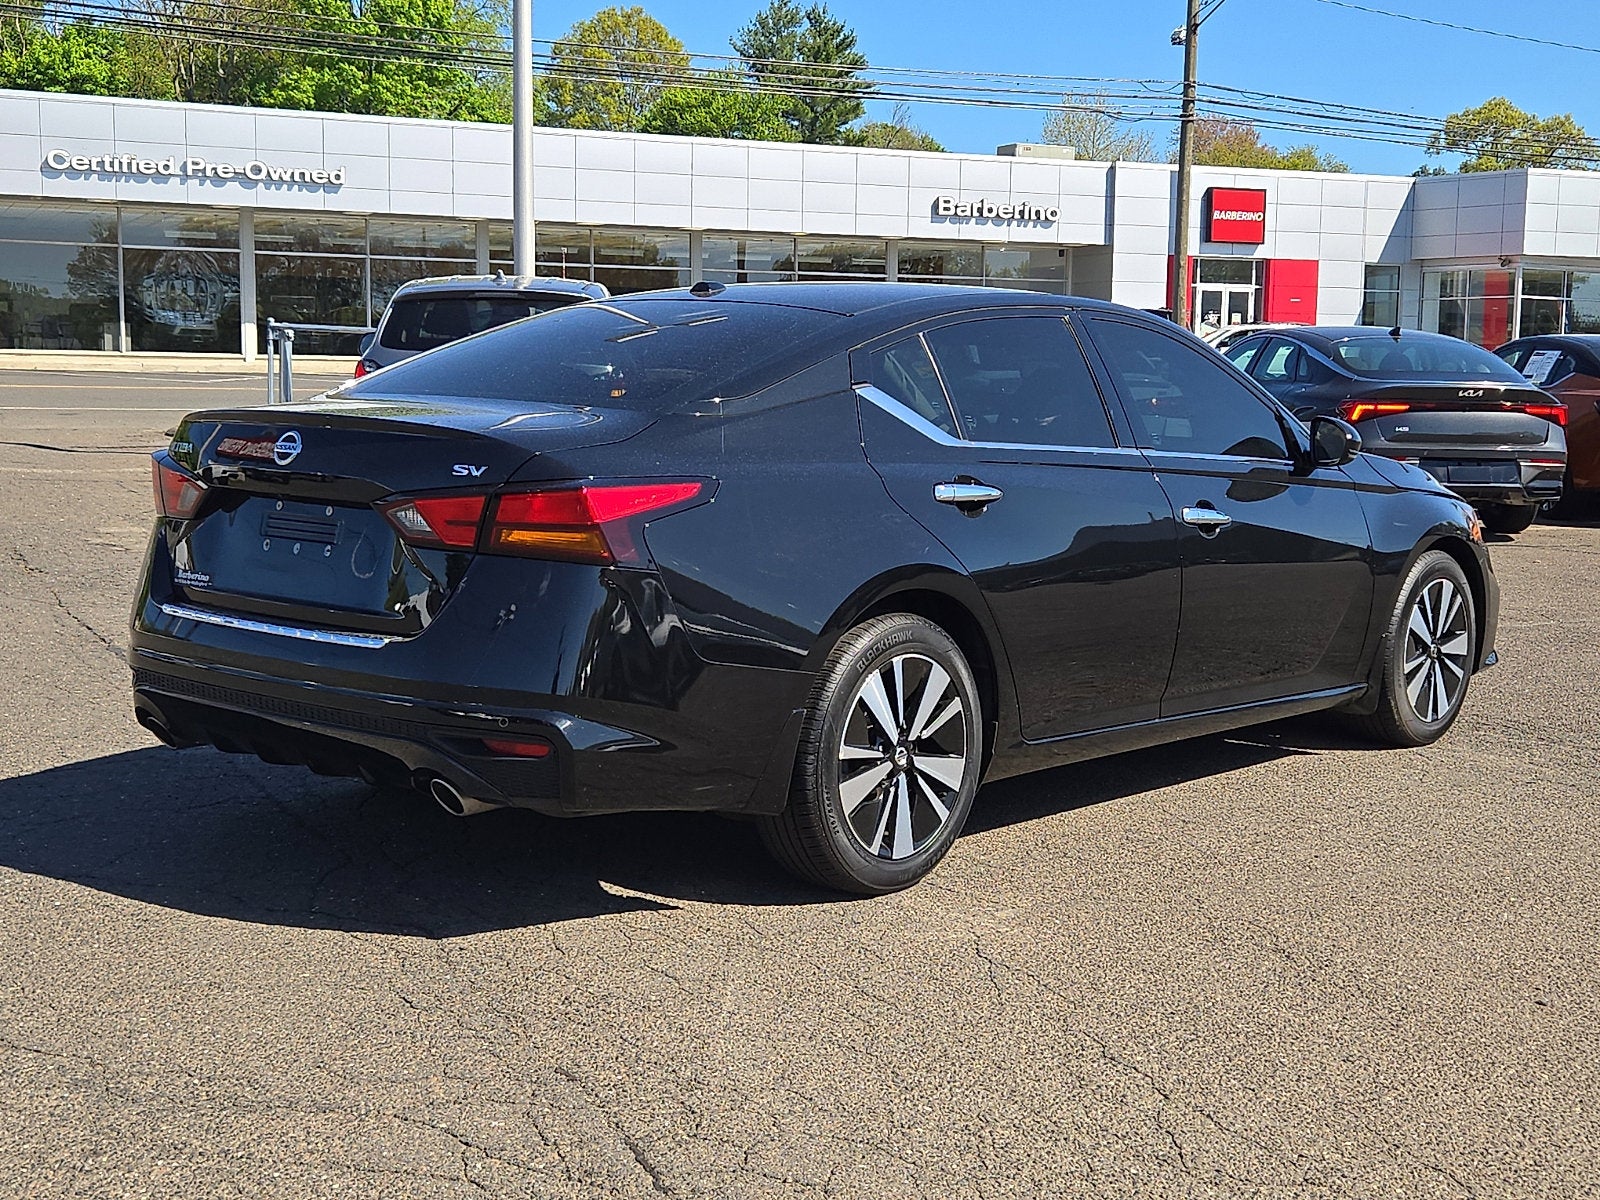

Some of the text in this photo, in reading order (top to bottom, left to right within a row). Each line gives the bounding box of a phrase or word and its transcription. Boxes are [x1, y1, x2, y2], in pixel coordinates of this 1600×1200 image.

[47, 149, 346, 185] Certified Pre-Owned
[938, 196, 1062, 222] Barberino
[1213, 210, 1264, 222] BARBERINO
[1458, 389, 1484, 397] KIA
[452, 464, 489, 477] SV
[856, 630, 913, 673] BLACKHAWK
